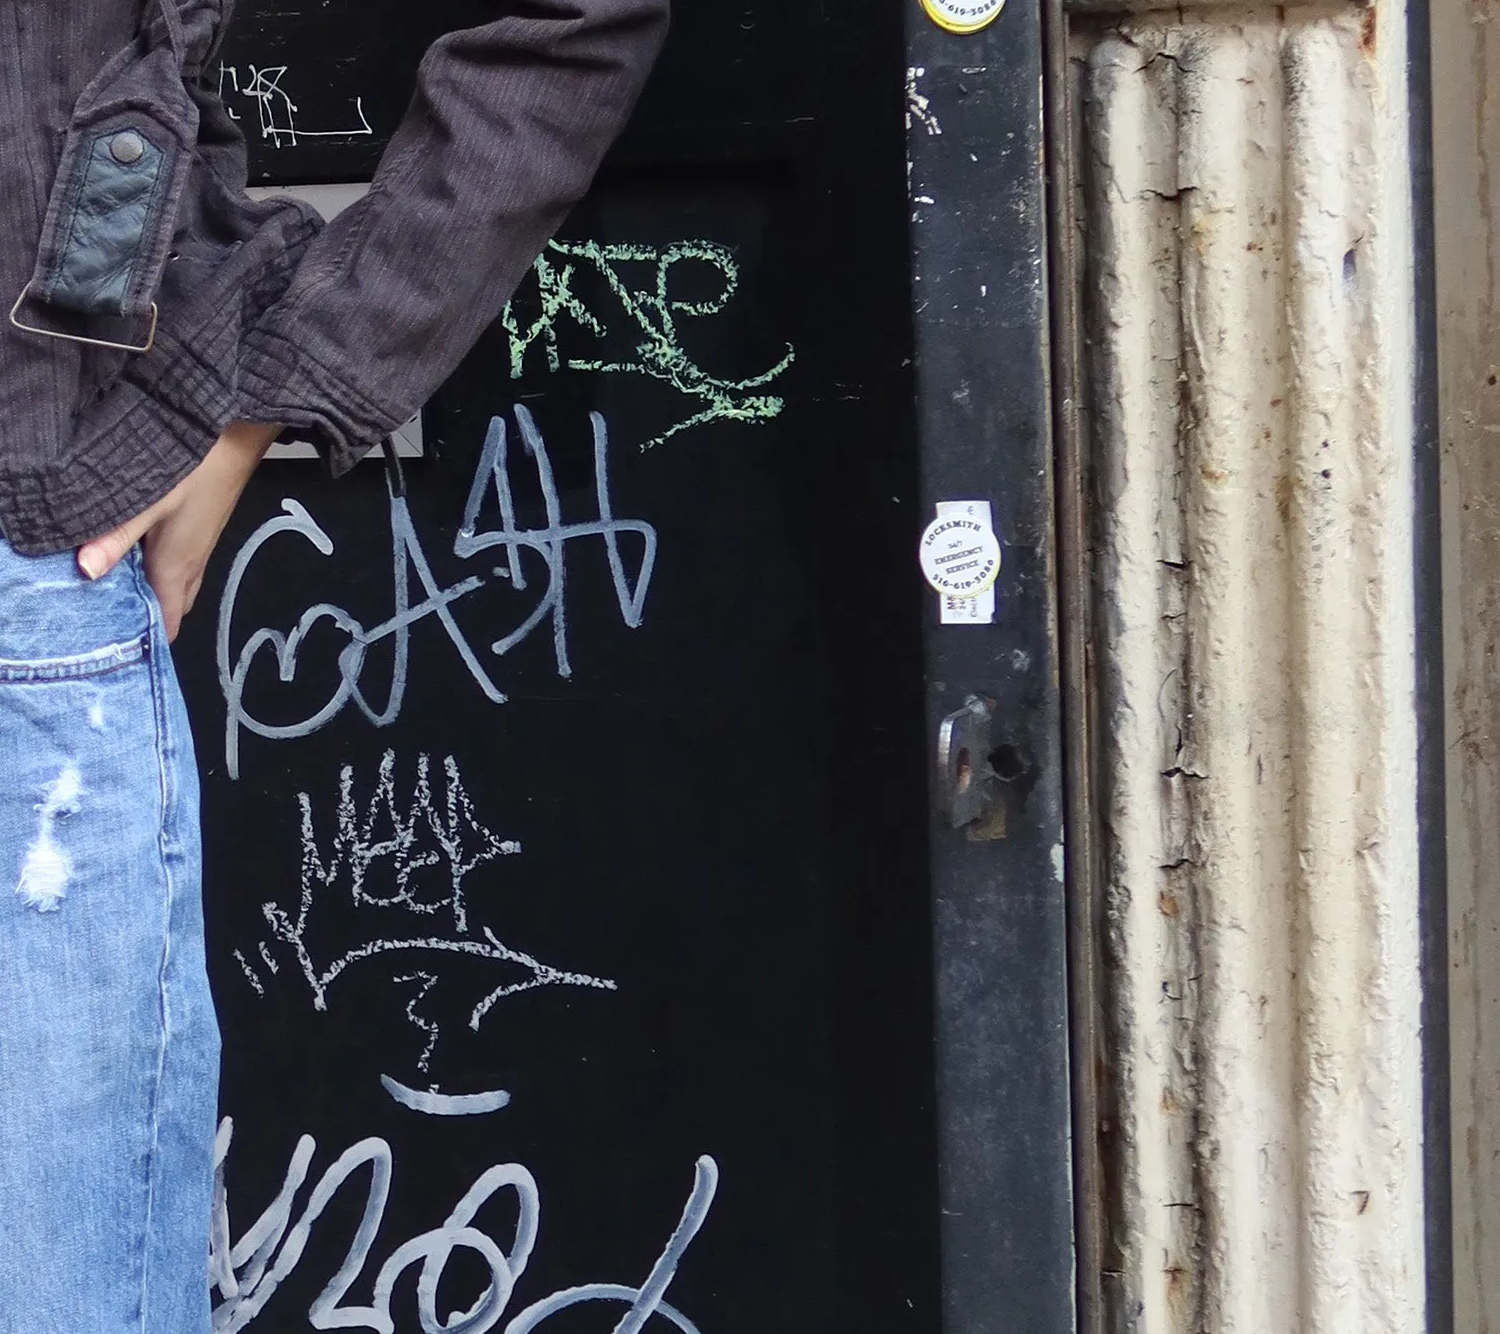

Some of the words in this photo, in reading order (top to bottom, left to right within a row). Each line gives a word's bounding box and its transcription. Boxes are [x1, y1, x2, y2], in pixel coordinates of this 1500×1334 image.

[925, 520, 982, 547] LOCKSMITH
[934, 546, 984, 566] EMERGENCY
[945, 559, 980, 575] SERVICE
